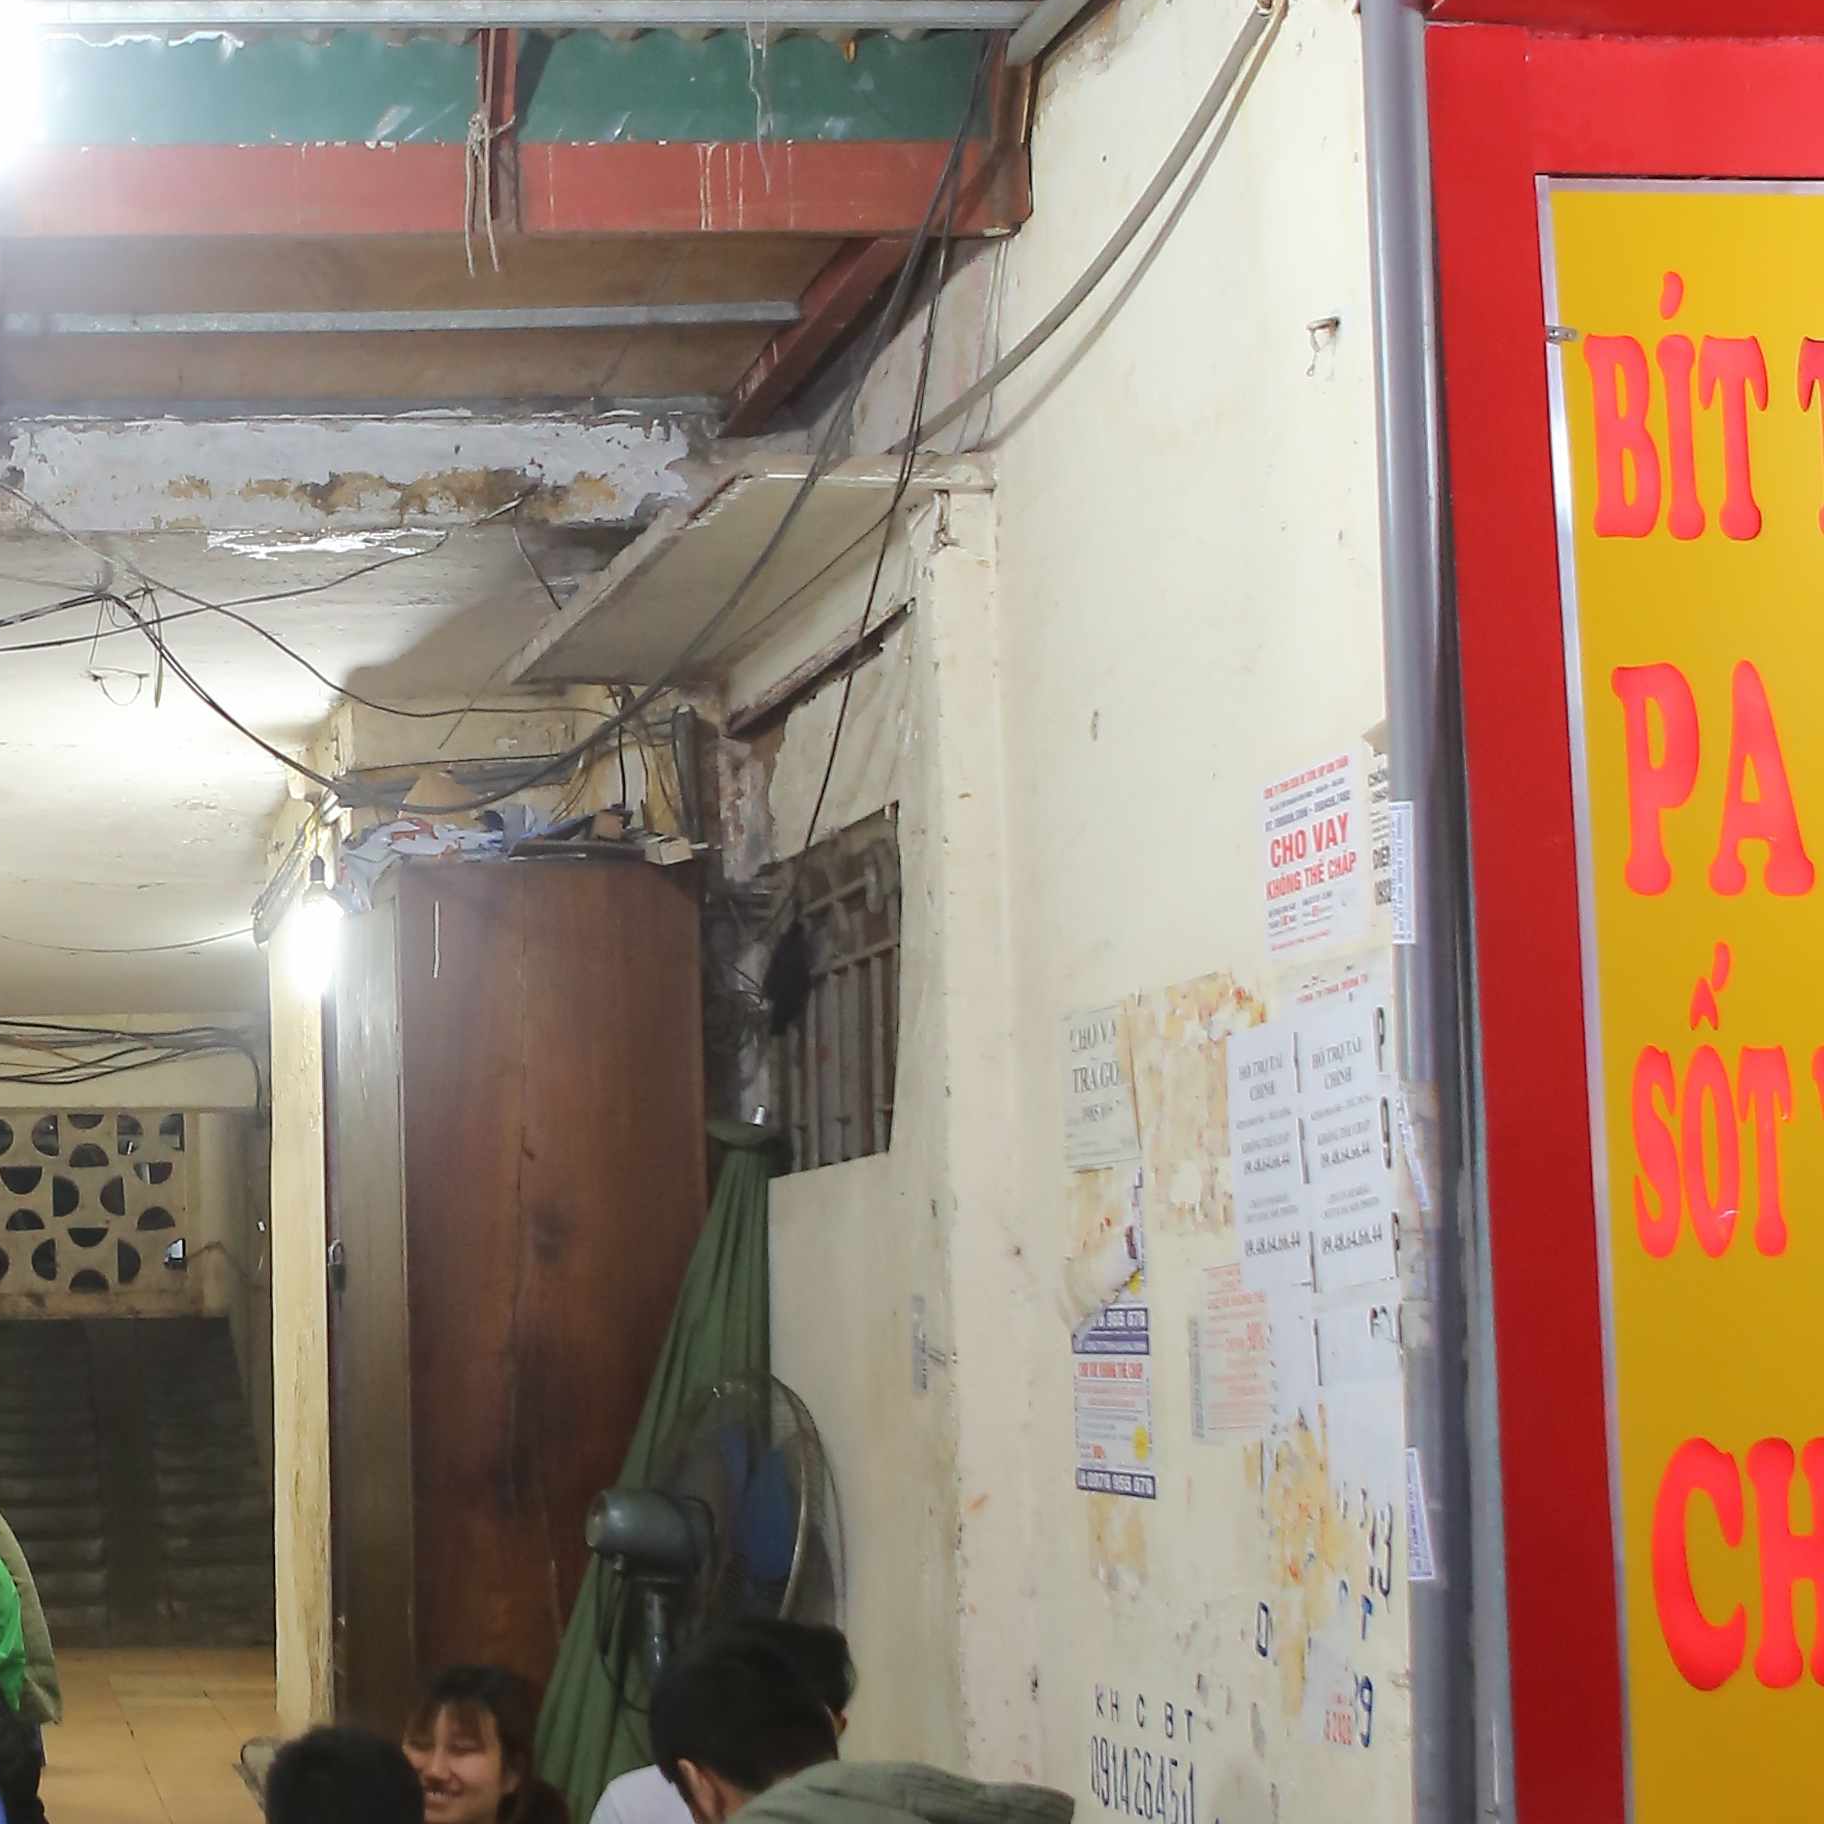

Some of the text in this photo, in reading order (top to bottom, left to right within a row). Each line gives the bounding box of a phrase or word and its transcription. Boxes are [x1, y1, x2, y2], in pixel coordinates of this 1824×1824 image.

[1583, 270, 1769, 542] BÍT
[1270, 812, 1350, 869] CHO VAY
[1611, 659, 1816, 899] PA
[1632, 940, 1796, 1259] SỐT
